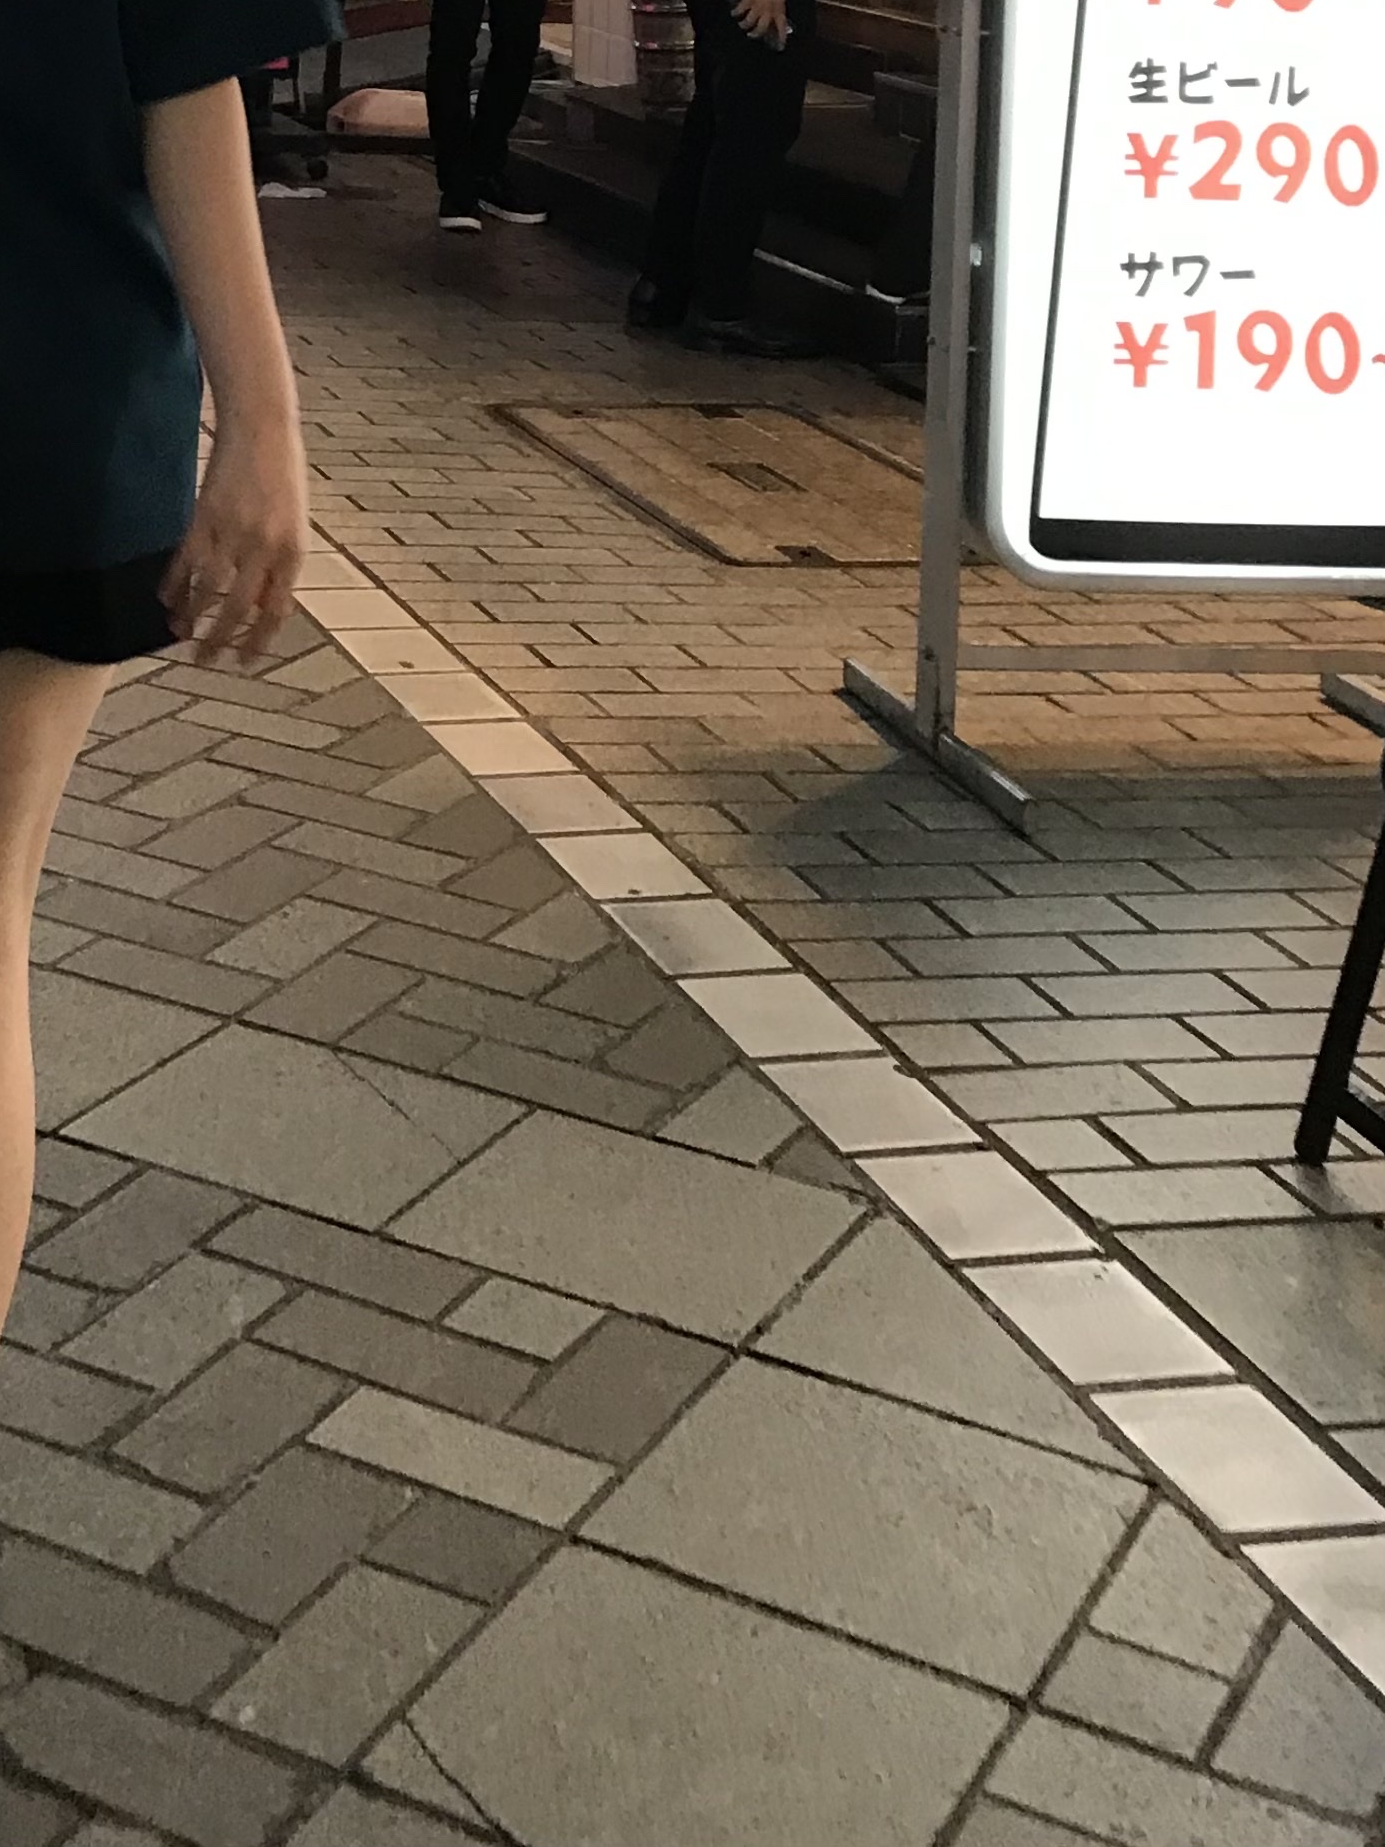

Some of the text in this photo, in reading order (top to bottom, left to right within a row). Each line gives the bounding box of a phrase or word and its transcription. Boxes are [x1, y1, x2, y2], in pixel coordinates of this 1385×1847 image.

[1127, 57, 1311, 108] 生ビール
[1124, 119, 1380, 208] ¥290
[1119, 250, 1256, 298] サワー
